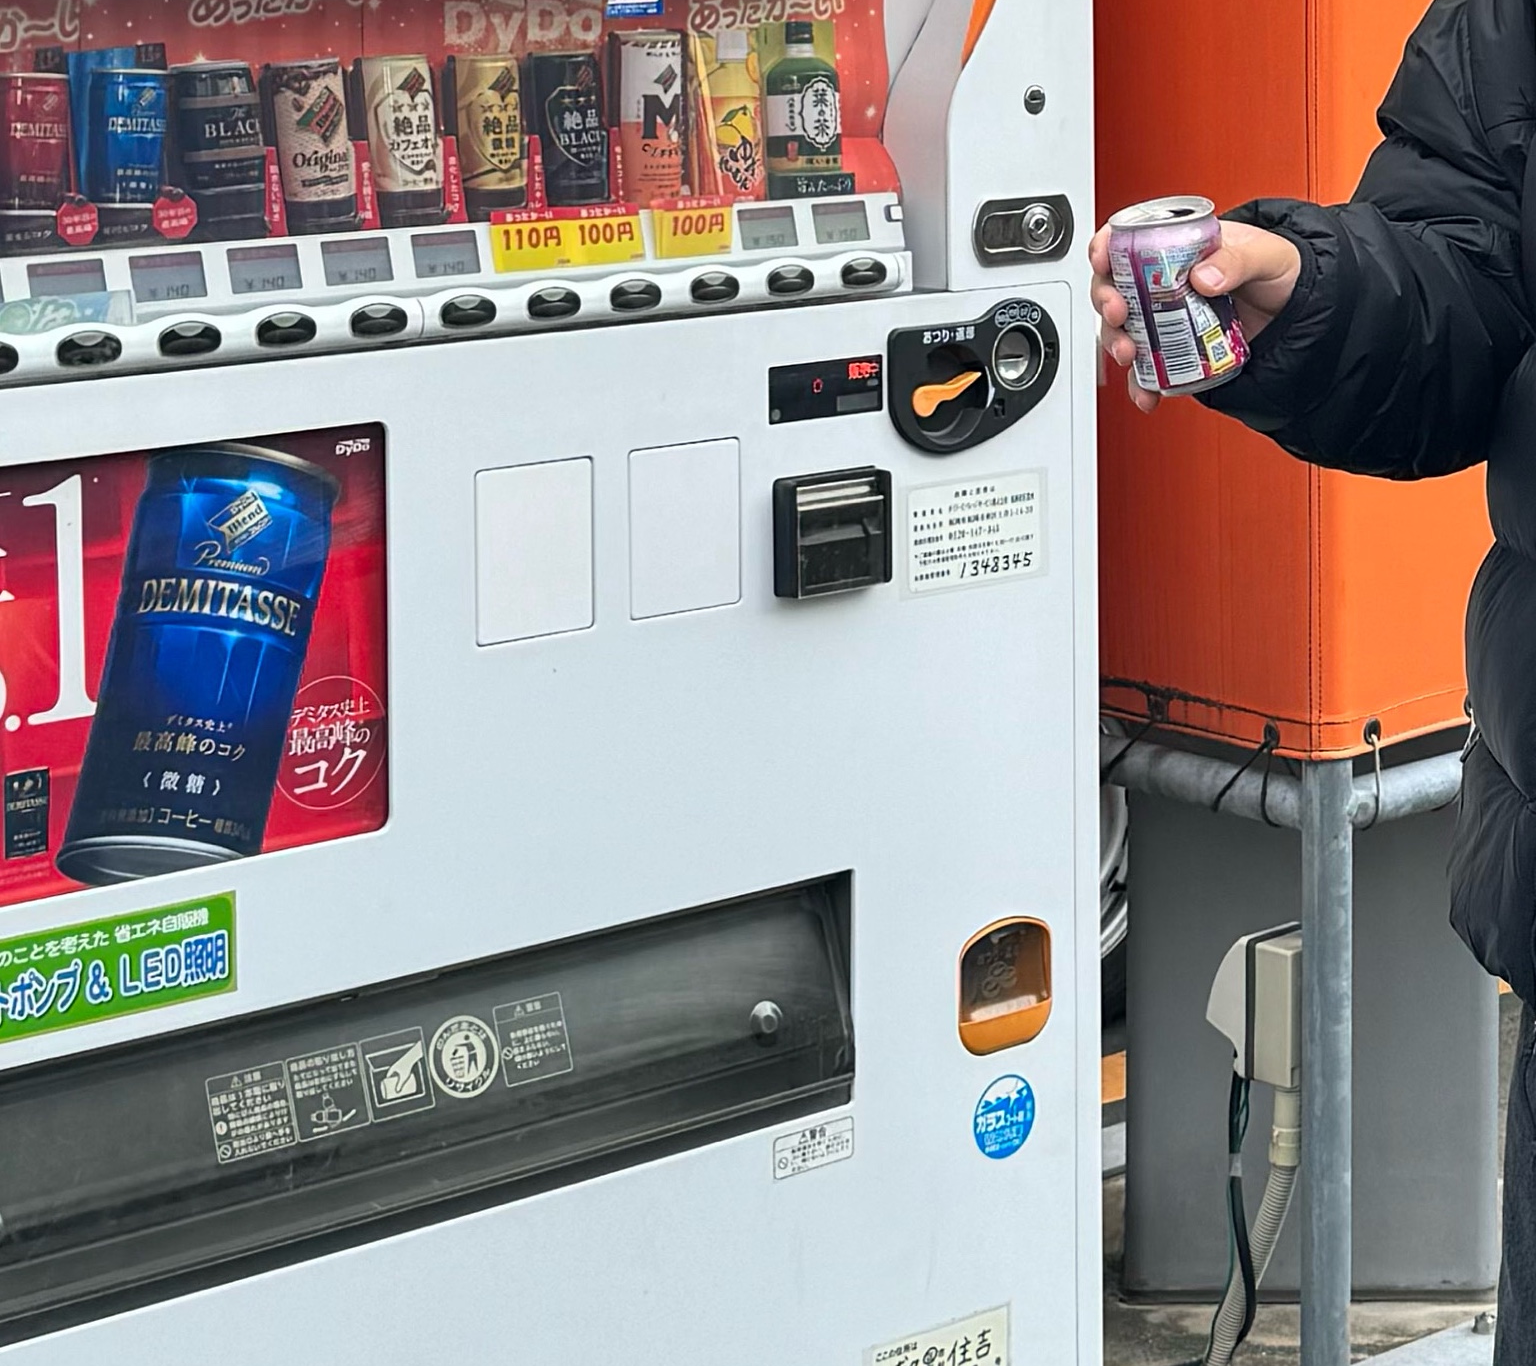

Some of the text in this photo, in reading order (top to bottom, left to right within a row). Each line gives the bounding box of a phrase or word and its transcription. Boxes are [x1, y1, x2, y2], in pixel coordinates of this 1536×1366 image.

[393, 114, 432, 136] 絶品
[482, 114, 519, 136] 絶品
[562, 109, 599, 131] 絶品
[812, 88, 831, 139] 葉の茶
[503, 225, 562, 251] 110円
[578, 221, 634, 246] 100円
[672, 212, 725, 237] 100円
[335, 438, 370, 457] DyDo
[194, 540, 271, 577] Premium
[960, 551, 1033, 579] 1348345
[137, 577, 301, 637] DEMITASSE
[292, 697, 371, 727] デミタス史上
[133, 731, 246, 763] 最高峰のコク
[288, 721, 371, 757] 最高峰の
[293, 747, 367, 796] コク
[88, 961, 111, 1003] &
[119, 931, 229, 997] LED照明
[445, 1068, 491, 1093] リサイクル
[976, 1112, 1006, 1134] ガラス
